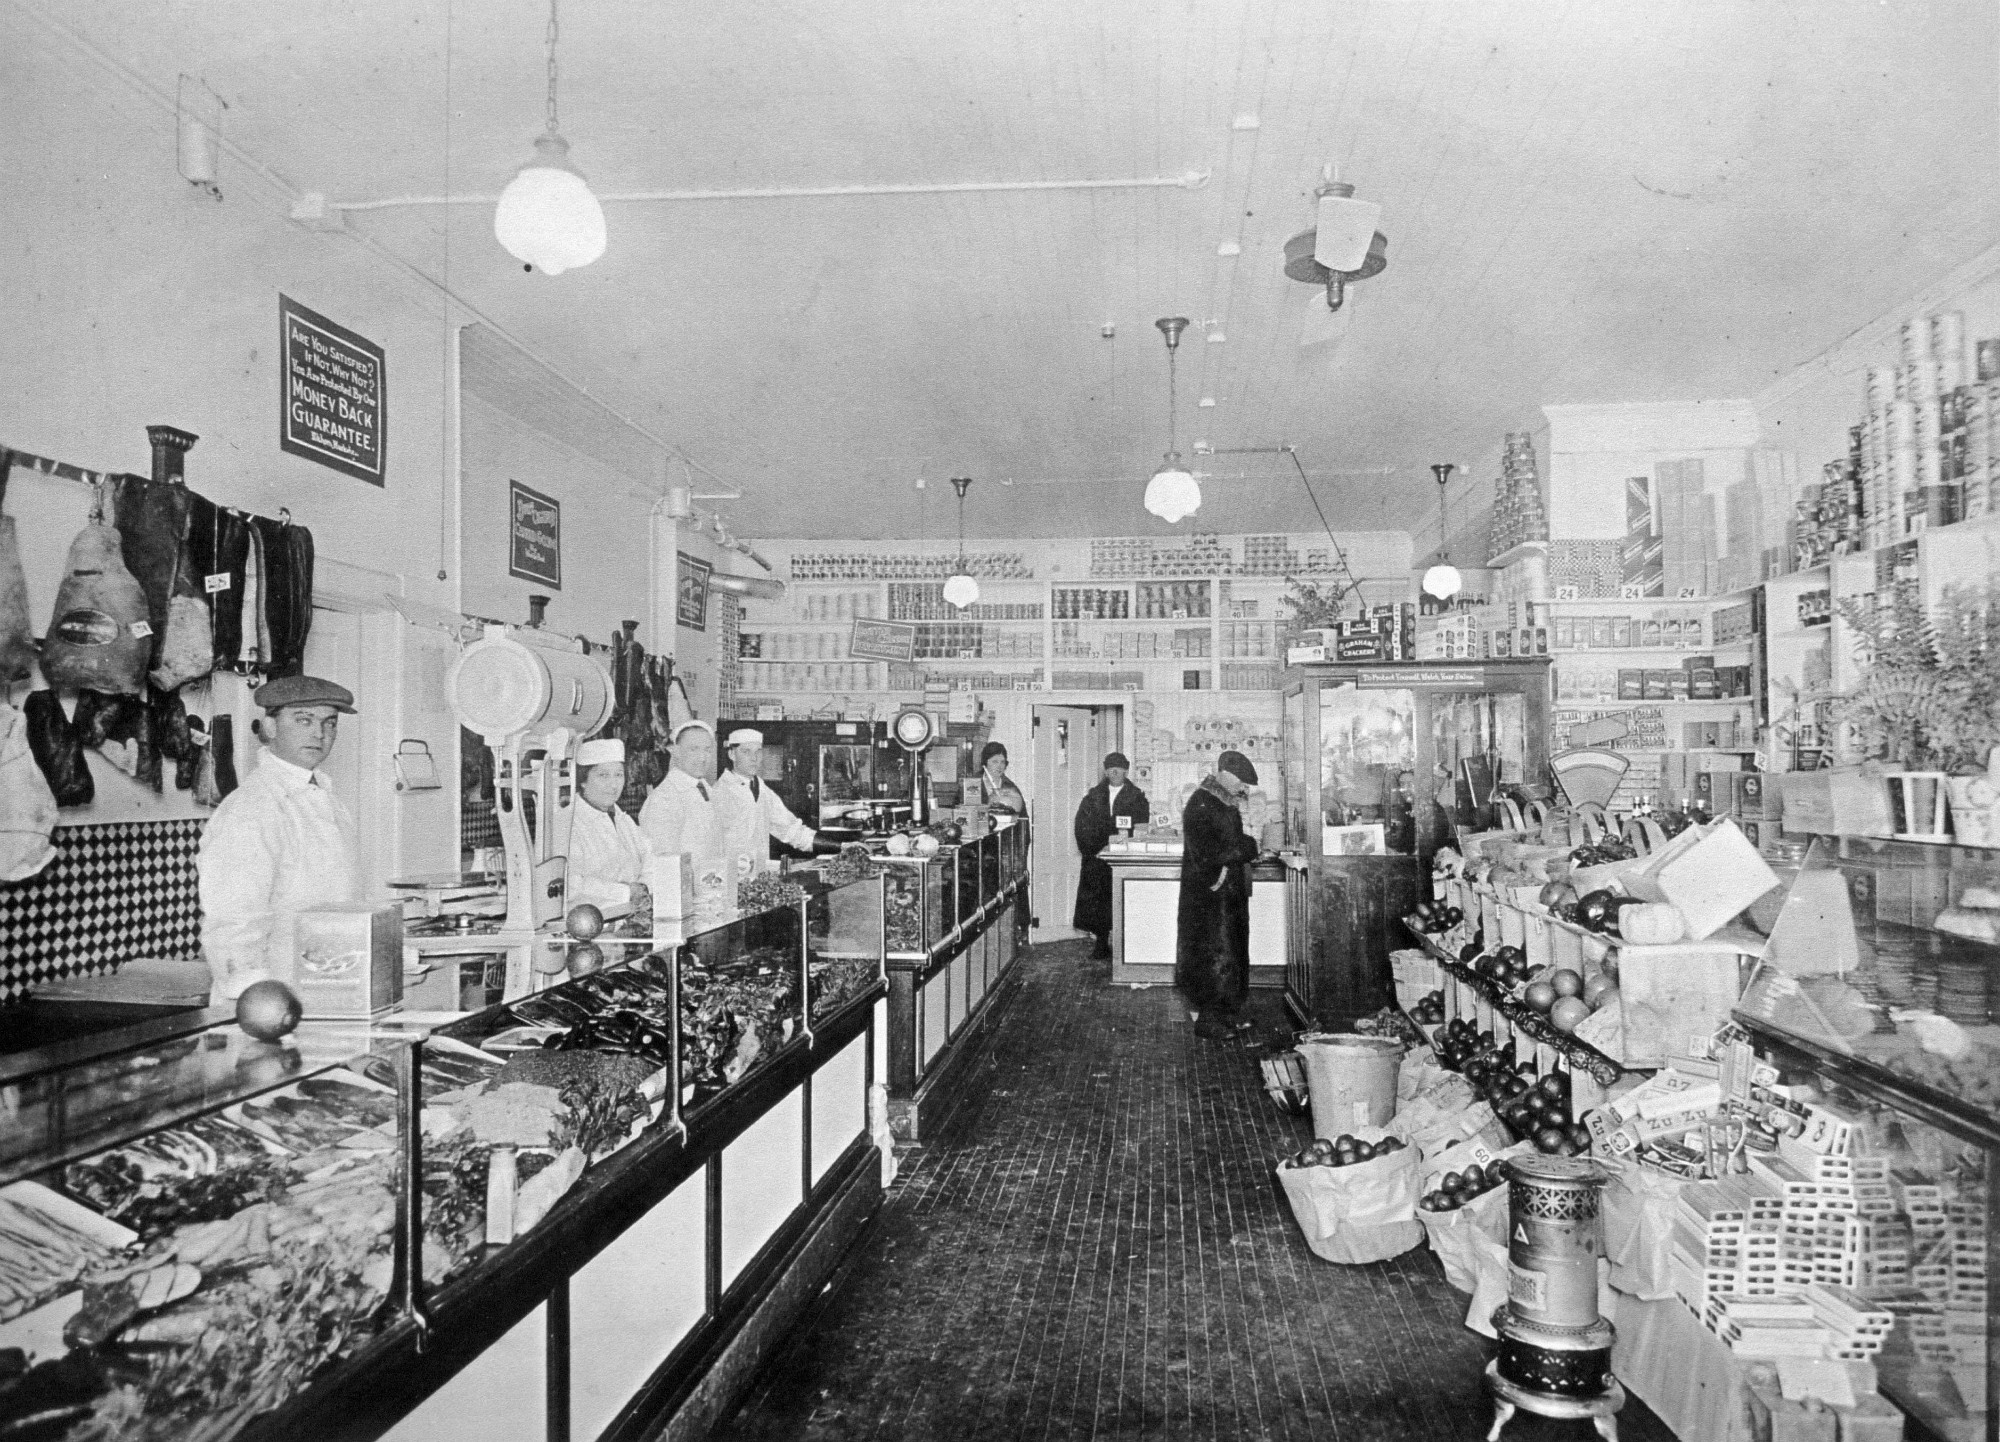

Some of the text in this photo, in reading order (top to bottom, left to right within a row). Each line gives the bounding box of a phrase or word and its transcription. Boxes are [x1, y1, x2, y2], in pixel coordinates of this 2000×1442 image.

[291, 327, 310, 347] ARE
[311, 335, 328, 356] YOU
[304, 349, 313, 363] IF
[332, 363, 350, 382] WHY
[291, 358, 377, 408] You Are Protected By Our
[291, 375, 373, 429] MONEY BACK
[291, 402, 375, 452] GUARANTEE.
[1559, 588, 1573, 599] 24
[1625, 588, 1639, 599] 24
[1680, 588, 1694, 598] 24
[1345, 639, 1373, 649] GRAHAM
[1343, 648, 1376, 657] CRACKERS
[1372, 673, 1395, 681] Protect
[1118, 818, 1128, 827] 39
[1158, 816, 1169, 825] 69
[1647, 1109, 1707, 1130] Zu Zu
[1592, 1115, 1605, 1136] Zu
